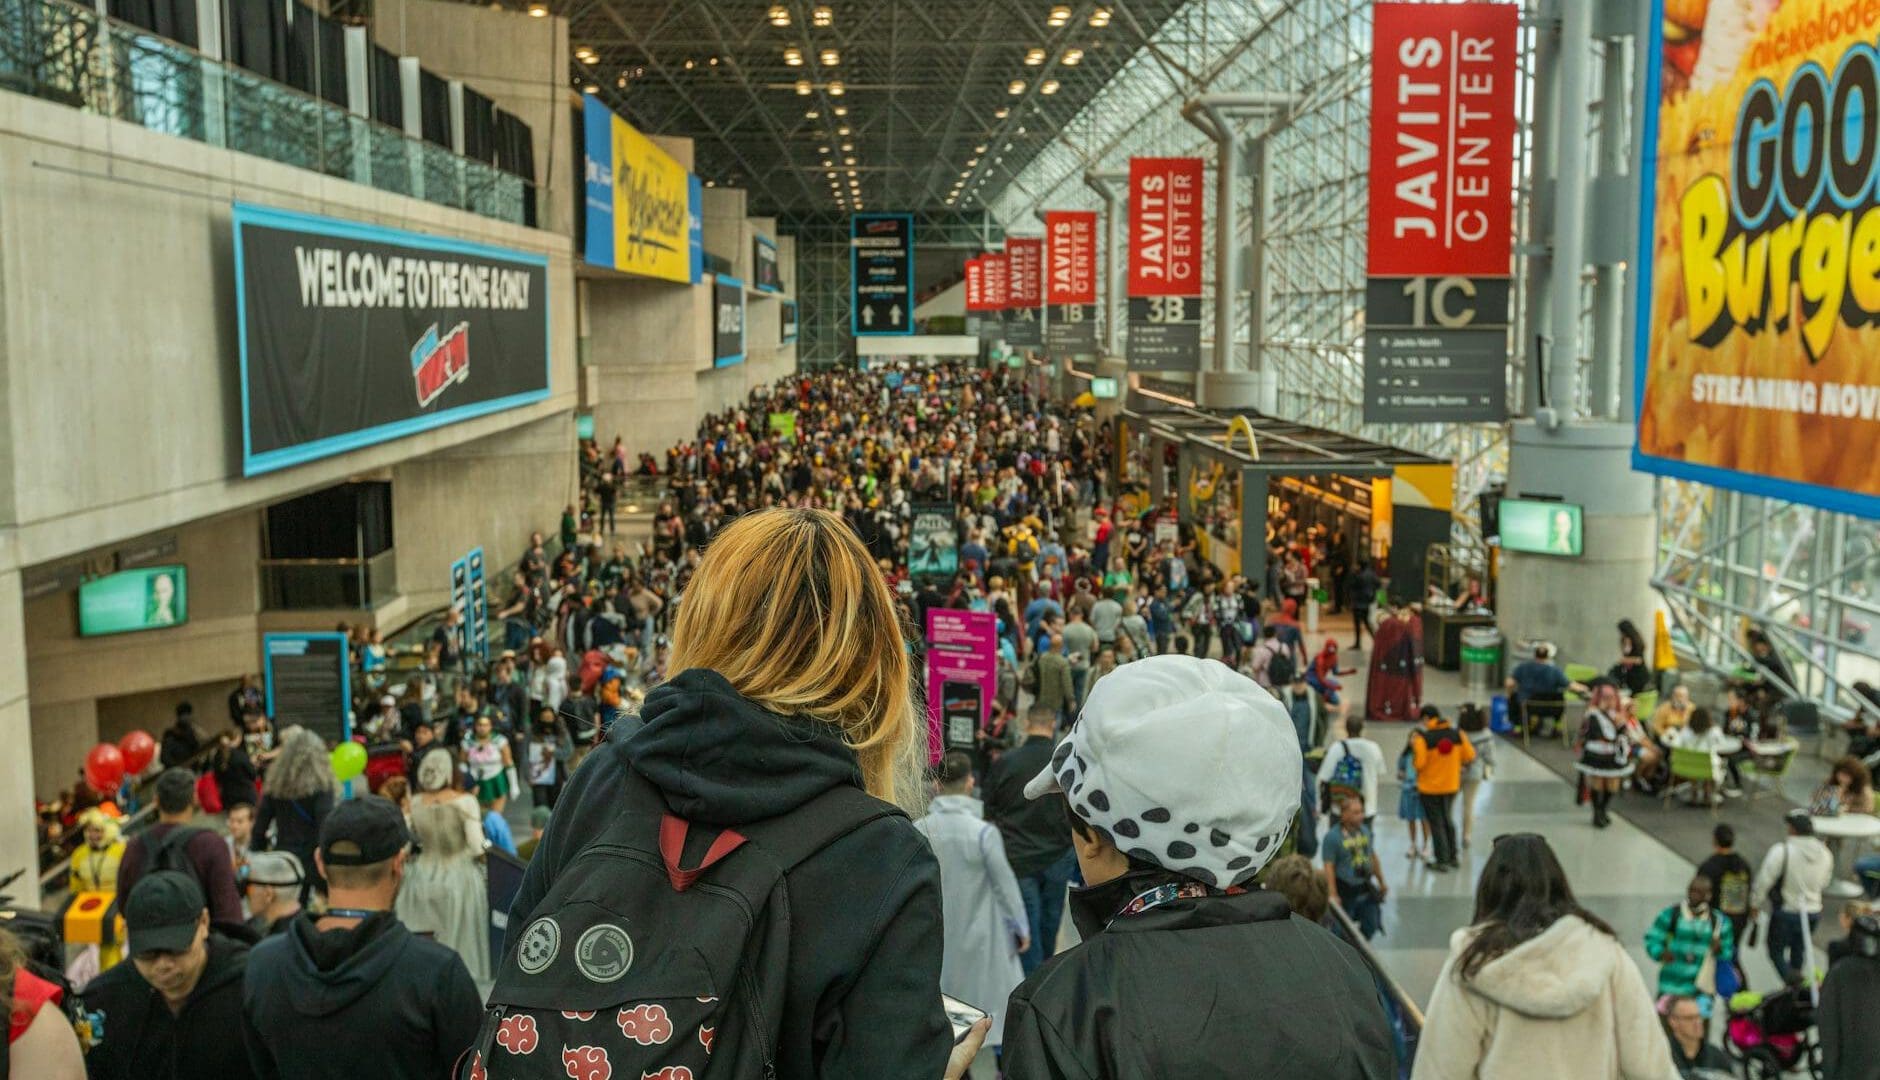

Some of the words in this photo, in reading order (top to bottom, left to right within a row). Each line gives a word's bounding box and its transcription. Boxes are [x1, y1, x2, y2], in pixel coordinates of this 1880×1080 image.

[1394, 37, 1443, 239] JAVITS
[1455, 37, 1495, 242] CENTER
[1733, 42, 1880, 229] GOO
[1053, 222, 1072, 293] JAVITS
[1075, 221, 1090, 294] CENTER
[1141, 175, 1165, 279] JAVITS
[1172, 174, 1192, 280] CENTER
[295, 246, 404, 308] WELCOME
[404, 259, 430, 309] TO
[429, 260, 460, 308] THE
[460, 264, 490, 309] ONE
[490, 267, 500, 309] &
[499, 269, 531, 310] ONLY
[1010, 246, 1024, 299] JAVITS
[1403, 276, 1477, 329] 1C
[1680, 173, 1880, 363] Burge
[1060, 304, 1083, 323] 1B
[1146, 296, 1185, 323] 3B
[1692, 374, 1817, 414] STREAMING
[1820, 382, 1880, 420] NOV
